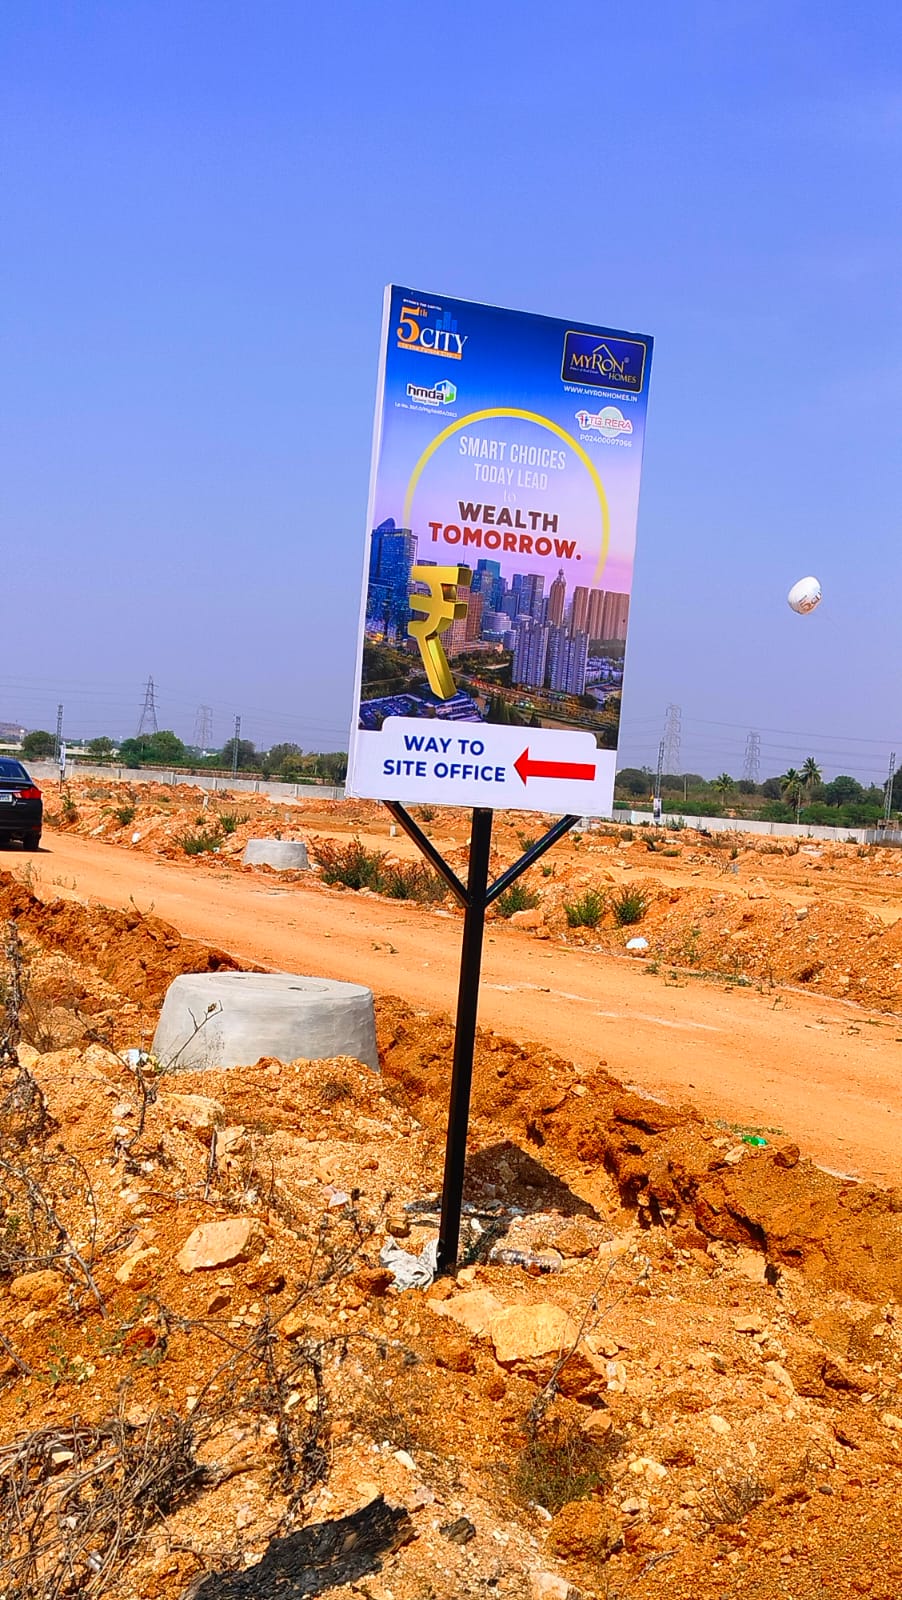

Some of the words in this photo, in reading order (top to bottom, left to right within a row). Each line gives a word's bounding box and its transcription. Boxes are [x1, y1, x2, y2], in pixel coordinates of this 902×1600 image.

[420, 328, 468, 354] CITY
[608, 372, 637, 384] HOMES
[407, 384, 444, 401] hmda
[564, 385, 637, 402] WWW.MYRONHOMES.IN
[590, 416, 603, 425] TG
[605, 418, 632, 430] RERA
[459, 436, 507, 460] SMART
[510, 444, 566, 470] CHOICES
[474, 463, 513, 485] TODAY
[518, 470, 548, 490] LEAD
[458, 501, 559, 533] WEALTH
[428, 522, 582, 560] TOMORROW.
[404, 735, 452, 754] WAY
[458, 739, 485, 756] TO
[383, 759, 427, 777] SITE
[433, 762, 506, 782] OFFICE
